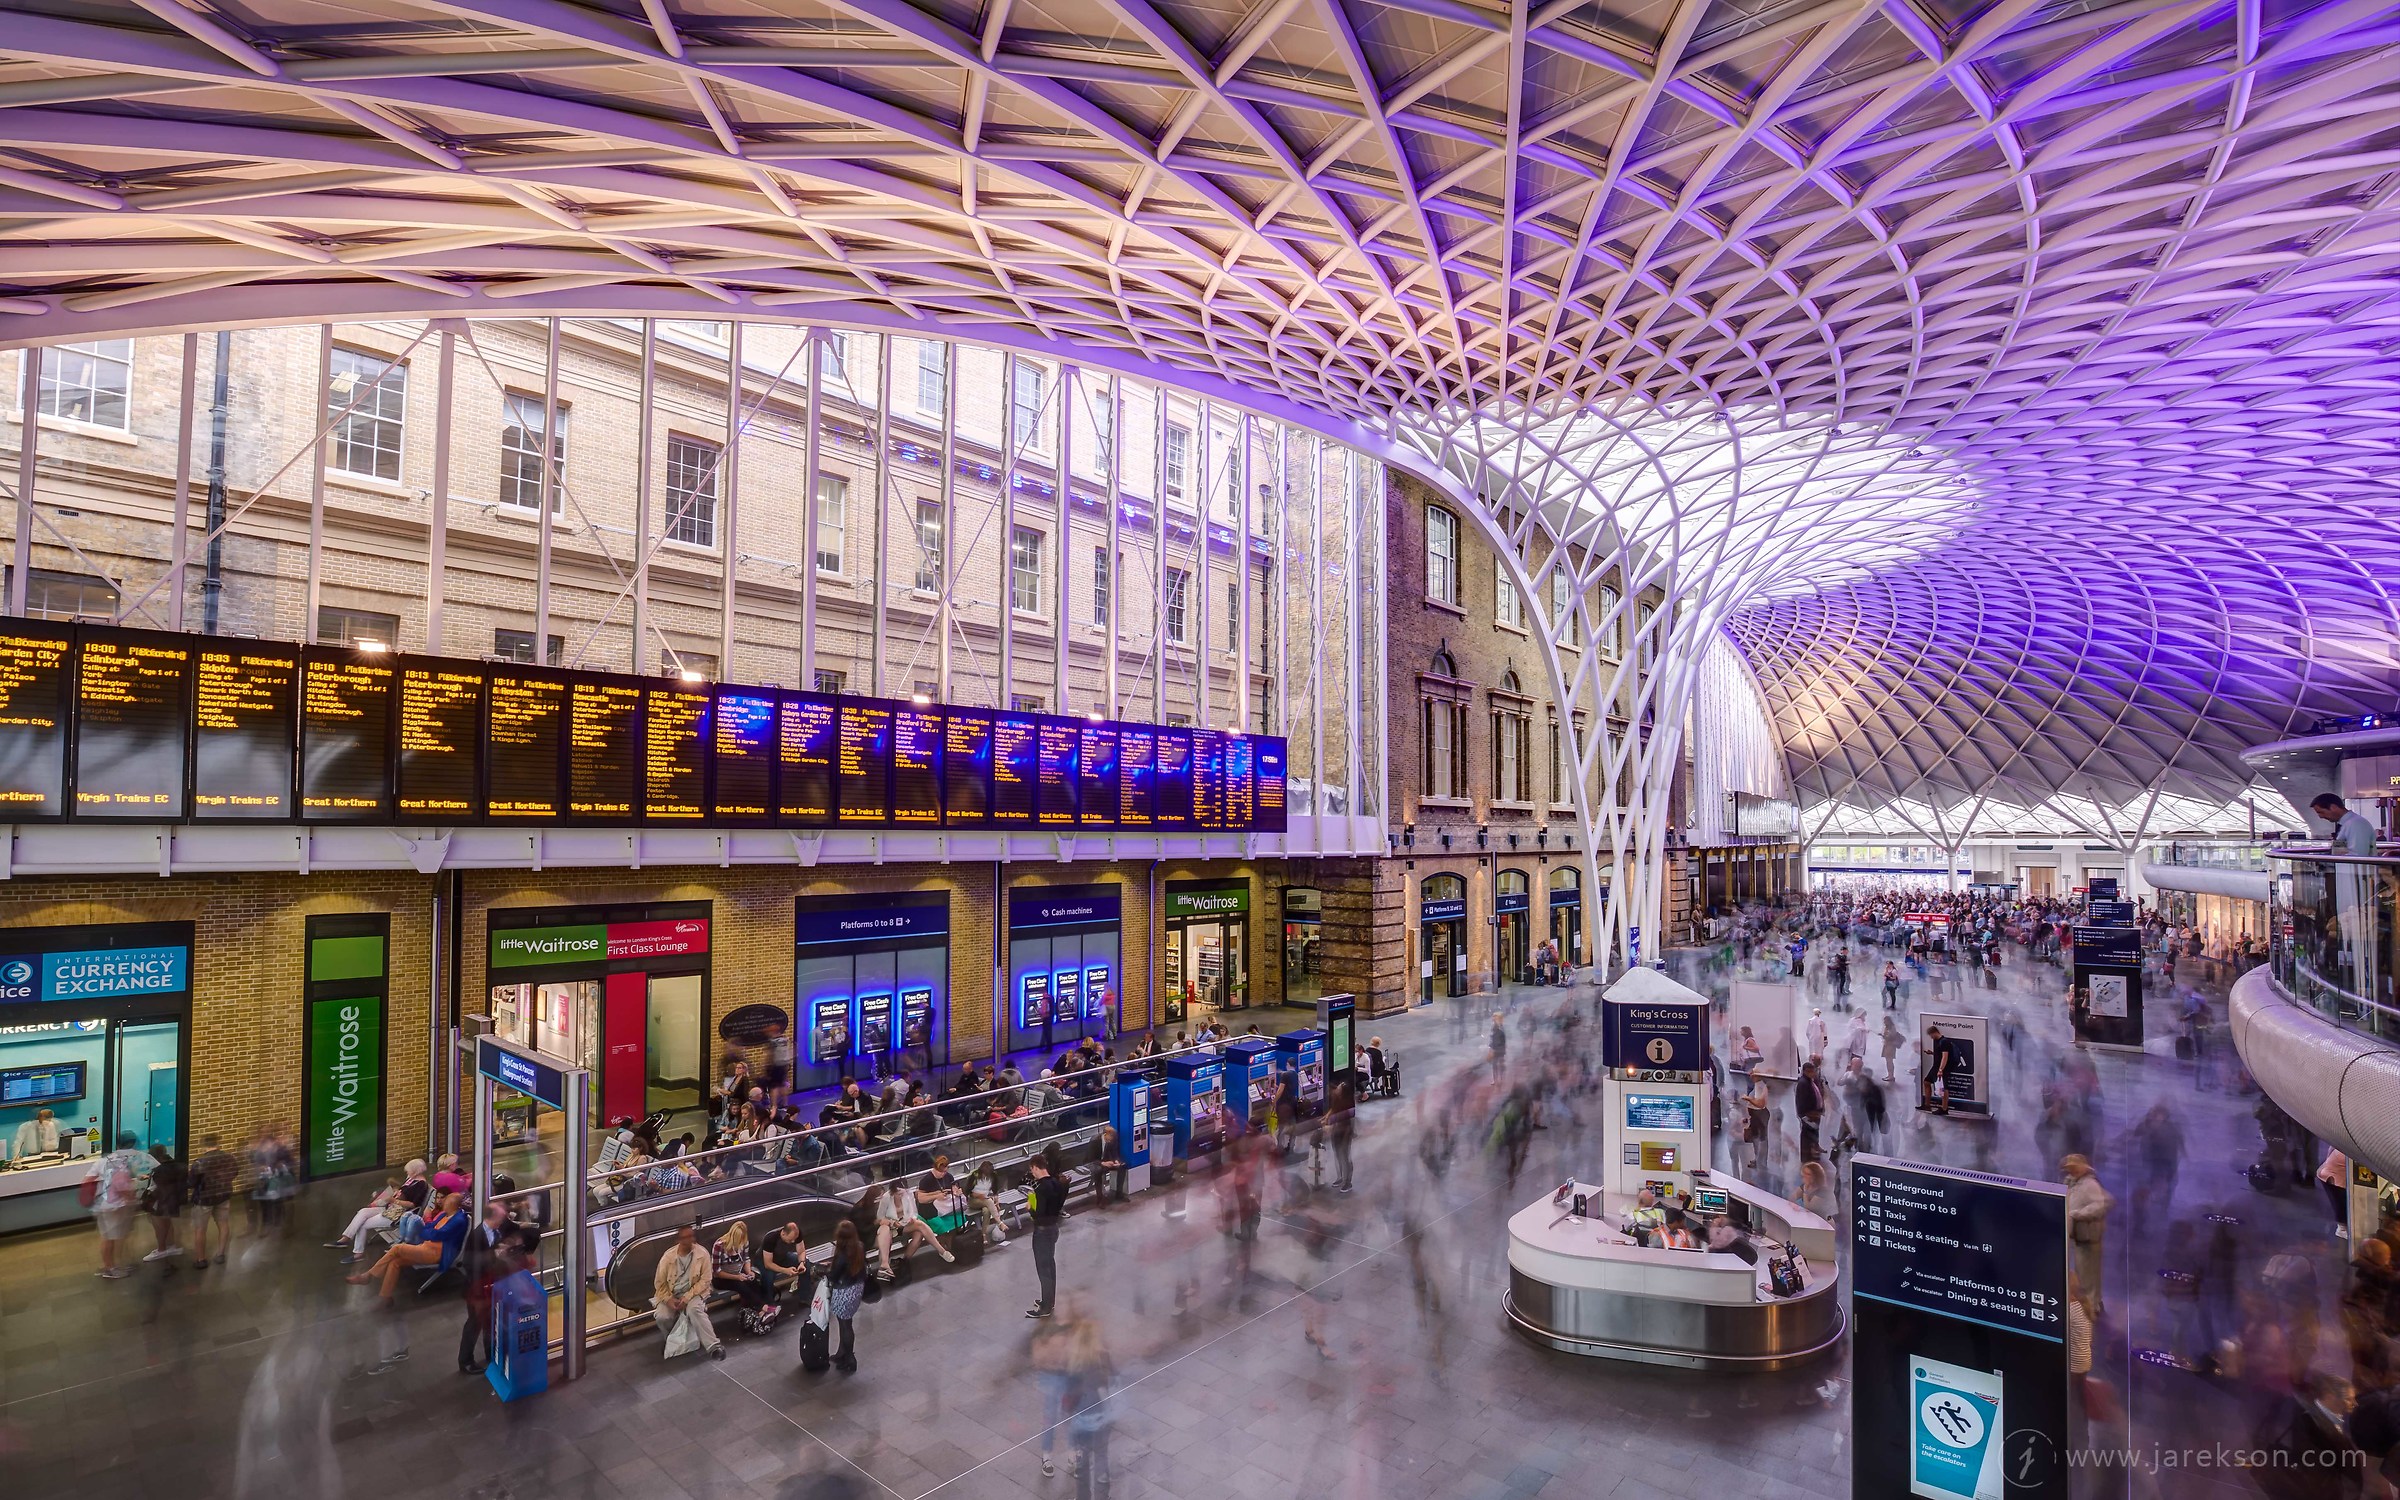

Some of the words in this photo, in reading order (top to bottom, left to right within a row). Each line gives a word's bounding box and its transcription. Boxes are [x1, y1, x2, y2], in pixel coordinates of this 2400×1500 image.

[85, 643, 117, 654] 18:00
[37, 650, 60, 660] City
[82, 654, 139, 666] Edinburgh
[201, 653, 230, 663] 18:03
[82, 664, 108, 672] Calling
[200, 663, 238, 675] Skipton
[309, 662, 335, 672] 18:10
[3, 672, 36, 681] Palace
[307, 672, 371, 684] Peterborough
[82, 678, 130, 688] Darlington
[199, 680, 253, 690] Peterborough
[404, 680, 462, 691] Peterborough
[82, 685, 126, 694] Newcastle
[573, 693, 609, 702] Newcastle
[718, 705, 749, 713] Cambridge
[198, 714, 234, 722] Keighley
[77, 793, 110, 804] Virgin
[115, 794, 151, 804] Trains
[154, 795, 169, 803] EC
[196, 795, 226, 805] Virgin
[230, 796, 262, 805] Trains
[266, 797, 279, 805] EC
[303, 798, 331, 807] Great
[334, 798, 376, 808] Northern
[400, 800, 425, 808] Great
[429, 800, 468, 808] Northern
[571, 803, 592, 812] Virgin
[594, 803, 617, 812] Trains
[620, 804, 630, 812] EC
[1178, 895, 1192, 905] little
[1192, 896, 1238, 910] Waitrose
[1052, 908, 1065, 916] Cash
[1066, 906, 1093, 915] machines
[840, 920, 873, 929] Platforms
[501, 938, 524, 950] little
[524, 938, 598, 954] Waitrose
[608, 946, 628, 955] First
[630, 945, 654, 953] Class
[656, 942, 688, 952] Lounge
[57, 952, 175, 964] INTERNATIONAL
[56, 959, 174, 979] CURRENCY
[56, 974, 173, 995] EXCHANGE
[0, 986, 31, 998] ice
[1630, 1009, 1659, 1020] King's
[1660, 1011, 1688, 1019] Cross
[332, 1005, 360, 1126] Waitrose
[503, 1067, 521, 1082] Underground
[522, 1075, 532, 1086] Station
[326, 1126, 345, 1162] little
[1885, 1180, 1944, 1198] Underground
[1885, 1196, 1928, 1211] Platforms
[1938, 1205, 1948, 1214] to
[1950, 1207, 1957, 1215] 8
[1884, 1209, 1906, 1221] Taxis
[1885, 1224, 1913, 1238] Dining
[1926, 1233, 1959, 1248] seating
[1884, 1239, 1916, 1253] Tickets
[1924, 1272, 1945, 1282] escalator
[1950, 1276, 1995, 1292] Platforms
[2006, 1288, 2017, 1297] to
[2019, 1291, 2027, 1299] 8
[1922, 1287, 1943, 1296] escalator
[1947, 1291, 1978, 1306] Dining
[1980, 1298, 1988, 1307] &
[1990, 1300, 2026, 1317] seating
[519, 1314, 540, 1323] METRO
[518, 1330, 540, 1344] FREE
[2140, 1354, 2181, 1368] Lifts
[1921, 1443, 1936, 1452] Take
[1937, 1448, 1951, 1456] care
[1933, 1454, 1966, 1468] escalators
